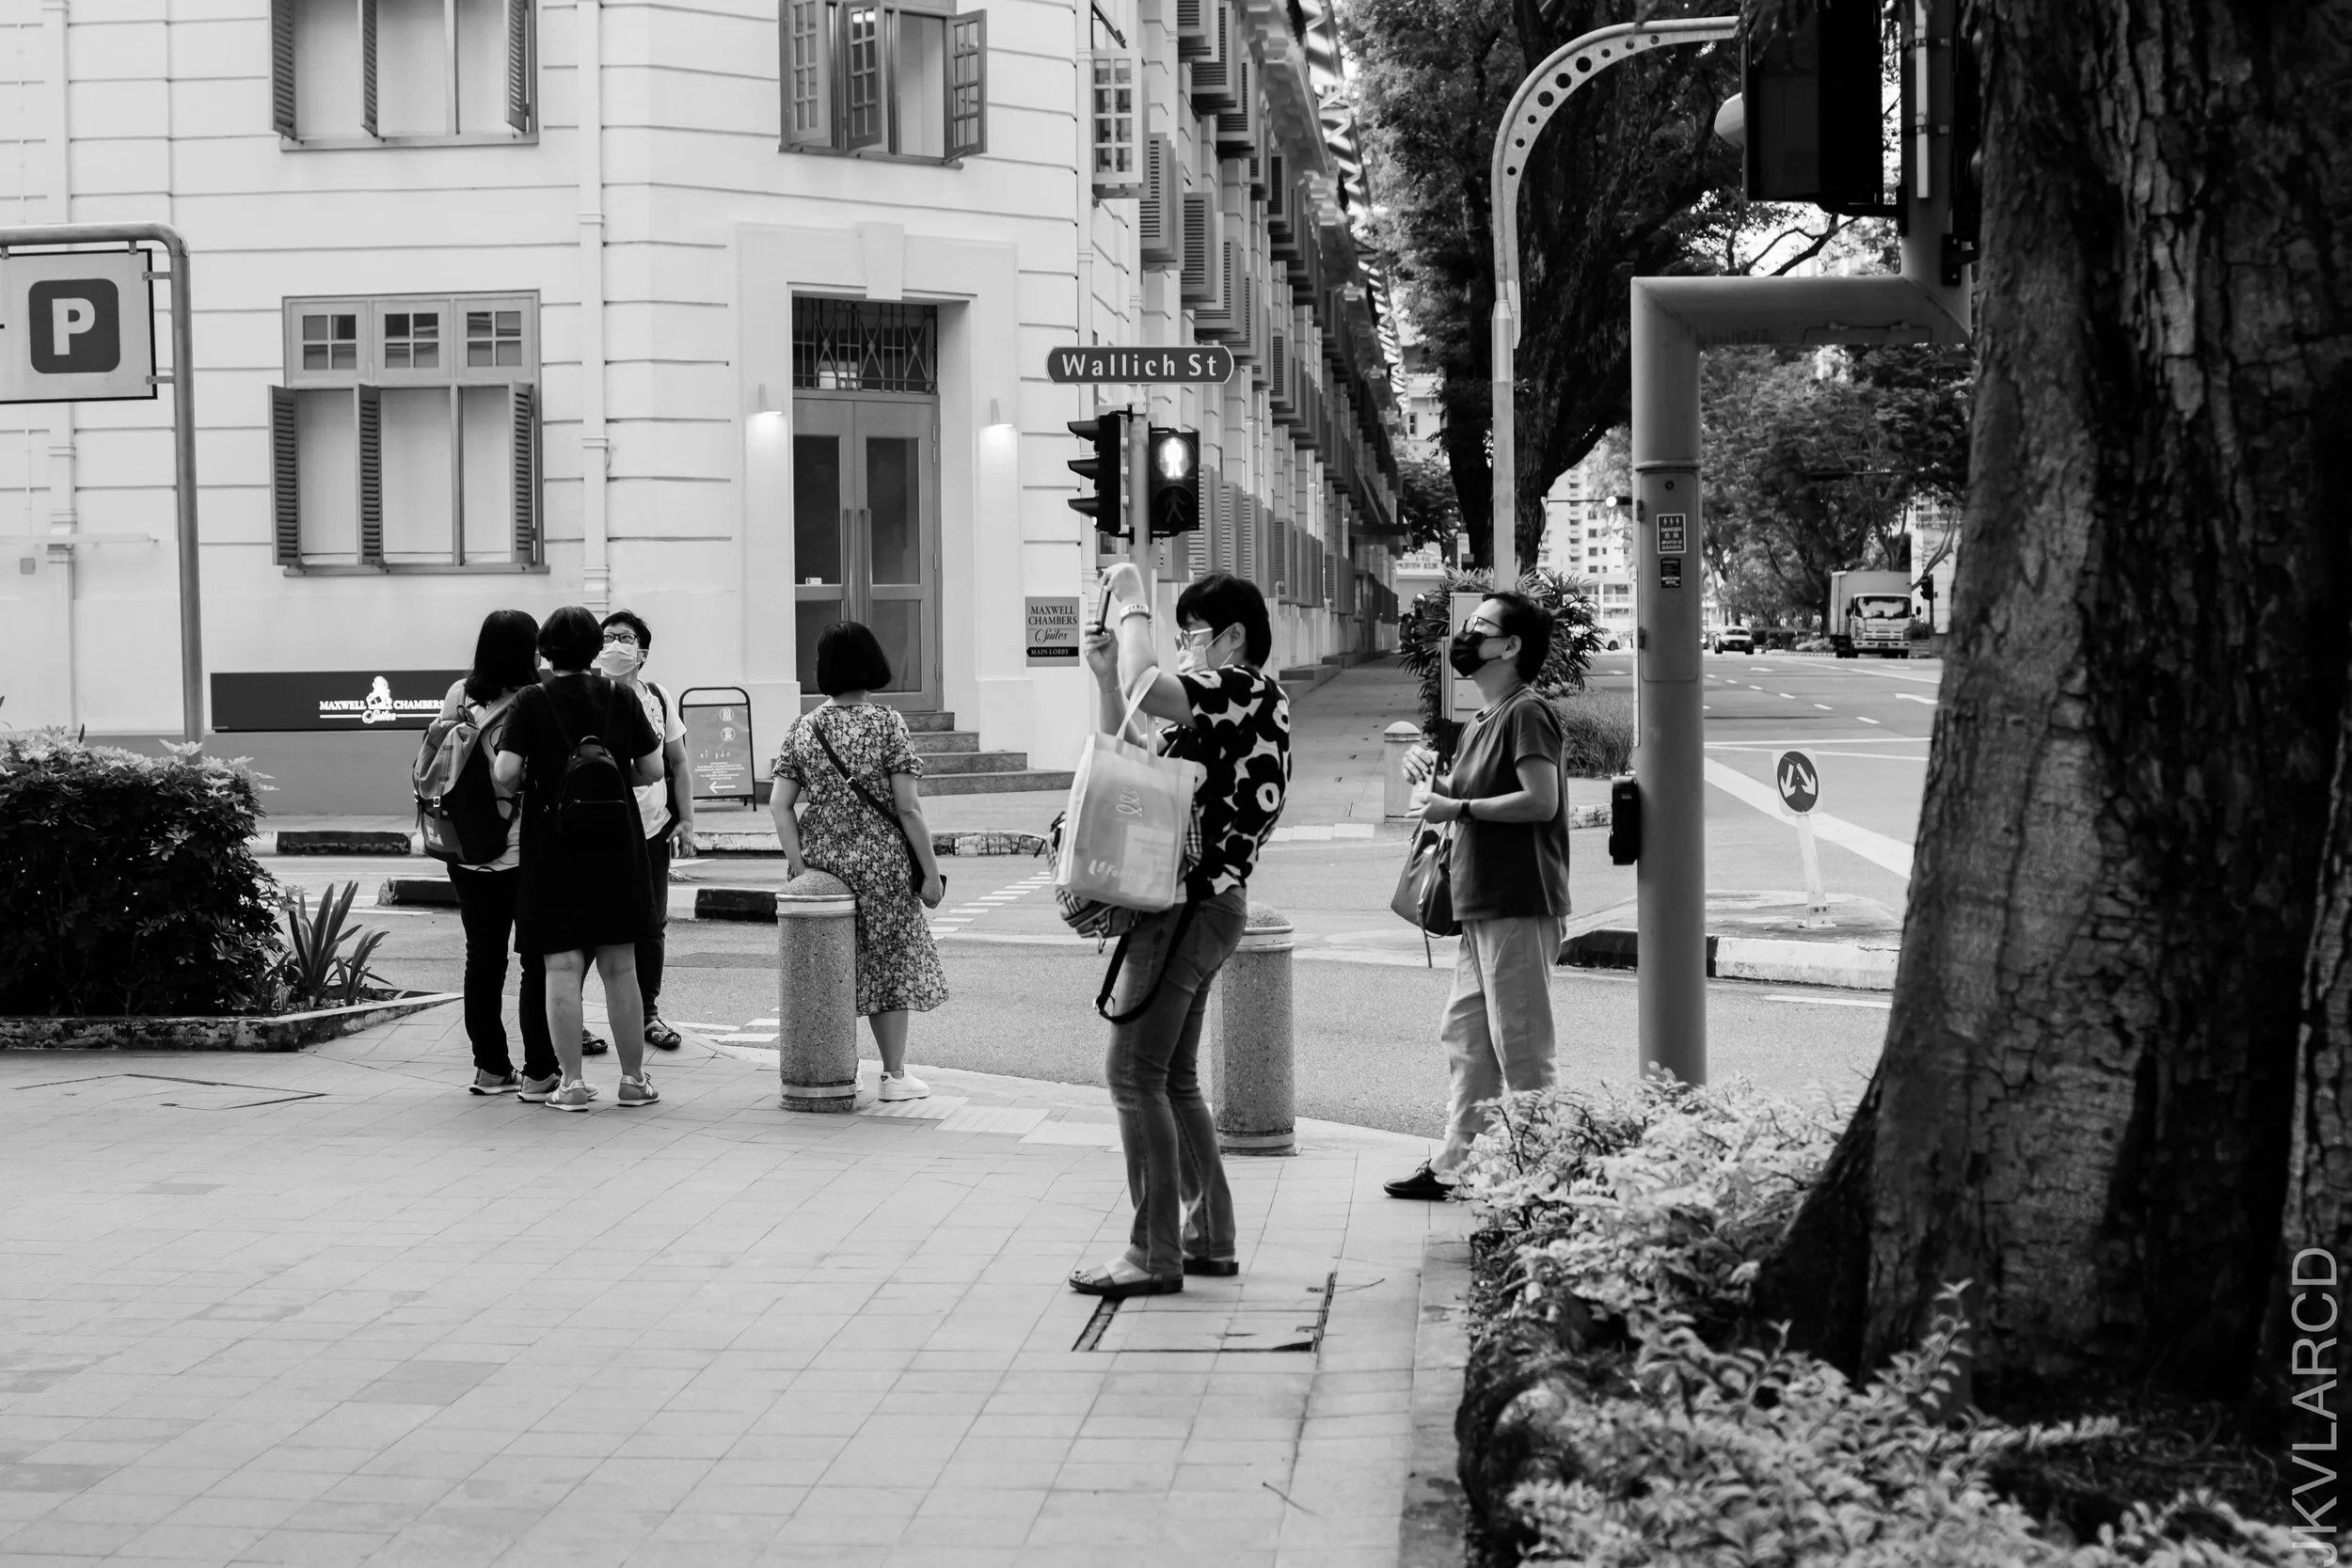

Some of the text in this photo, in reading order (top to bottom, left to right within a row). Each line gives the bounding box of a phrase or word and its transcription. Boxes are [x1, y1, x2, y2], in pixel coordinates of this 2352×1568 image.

[52, 297, 95, 356] P
[1061, 354, 1216, 376] Wallich St
[1030, 605, 1075, 615] MAXWELL
[1028, 615, 1077, 626] CHAMBERS
[1035, 627, 1068, 644] Suites
[319, 699, 445, 710] MAXWELL CHAMBERS
[361, 709, 397, 724] Suites
